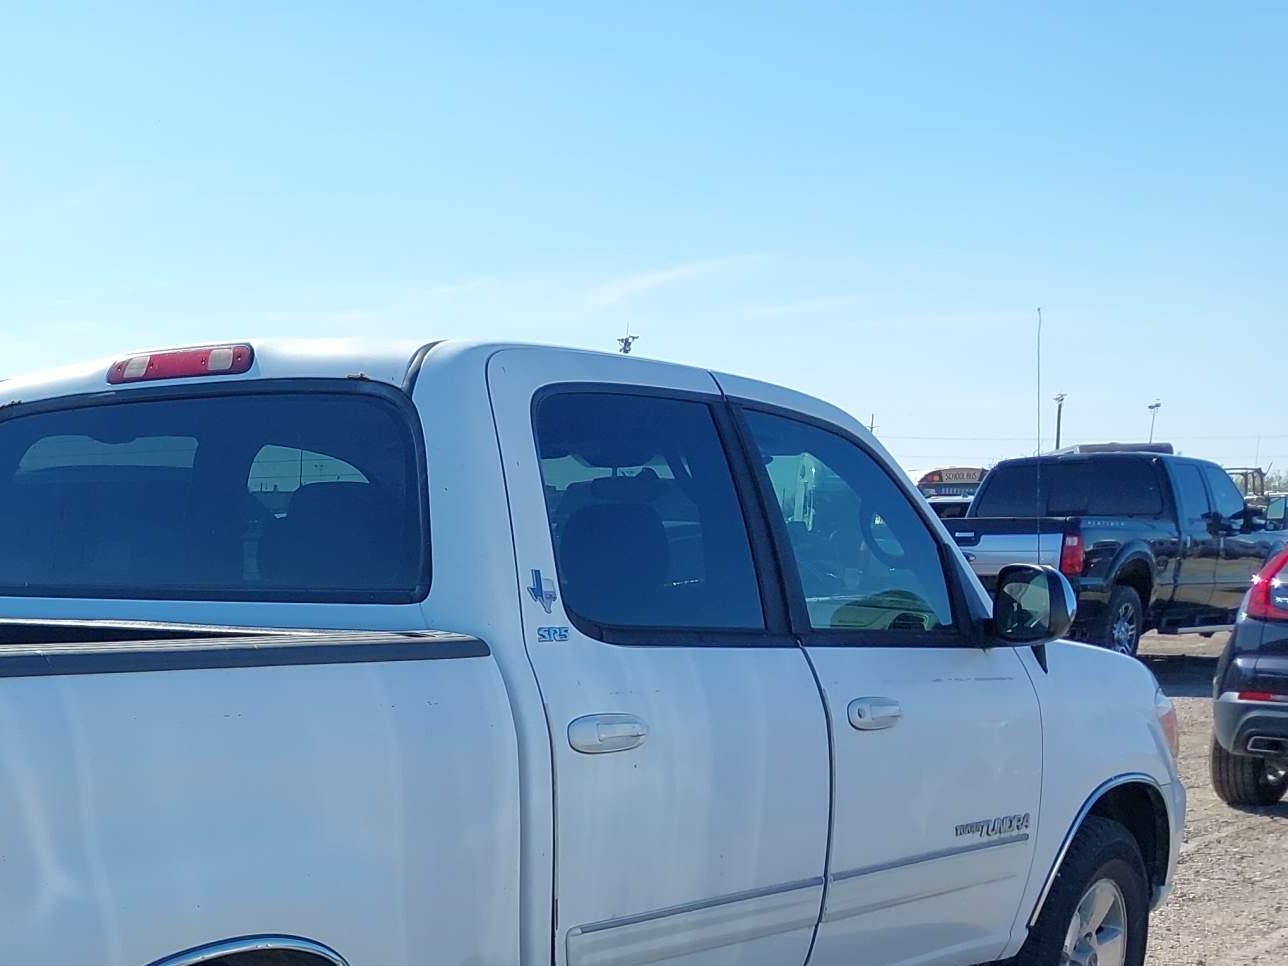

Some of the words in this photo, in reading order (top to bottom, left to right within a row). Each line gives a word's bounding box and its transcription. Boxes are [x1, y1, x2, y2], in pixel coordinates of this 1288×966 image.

[945, 471, 966, 481] SCHOOL
[966, 470, 977, 480] BUS
[978, 812, 1030, 838] TUNDRA
